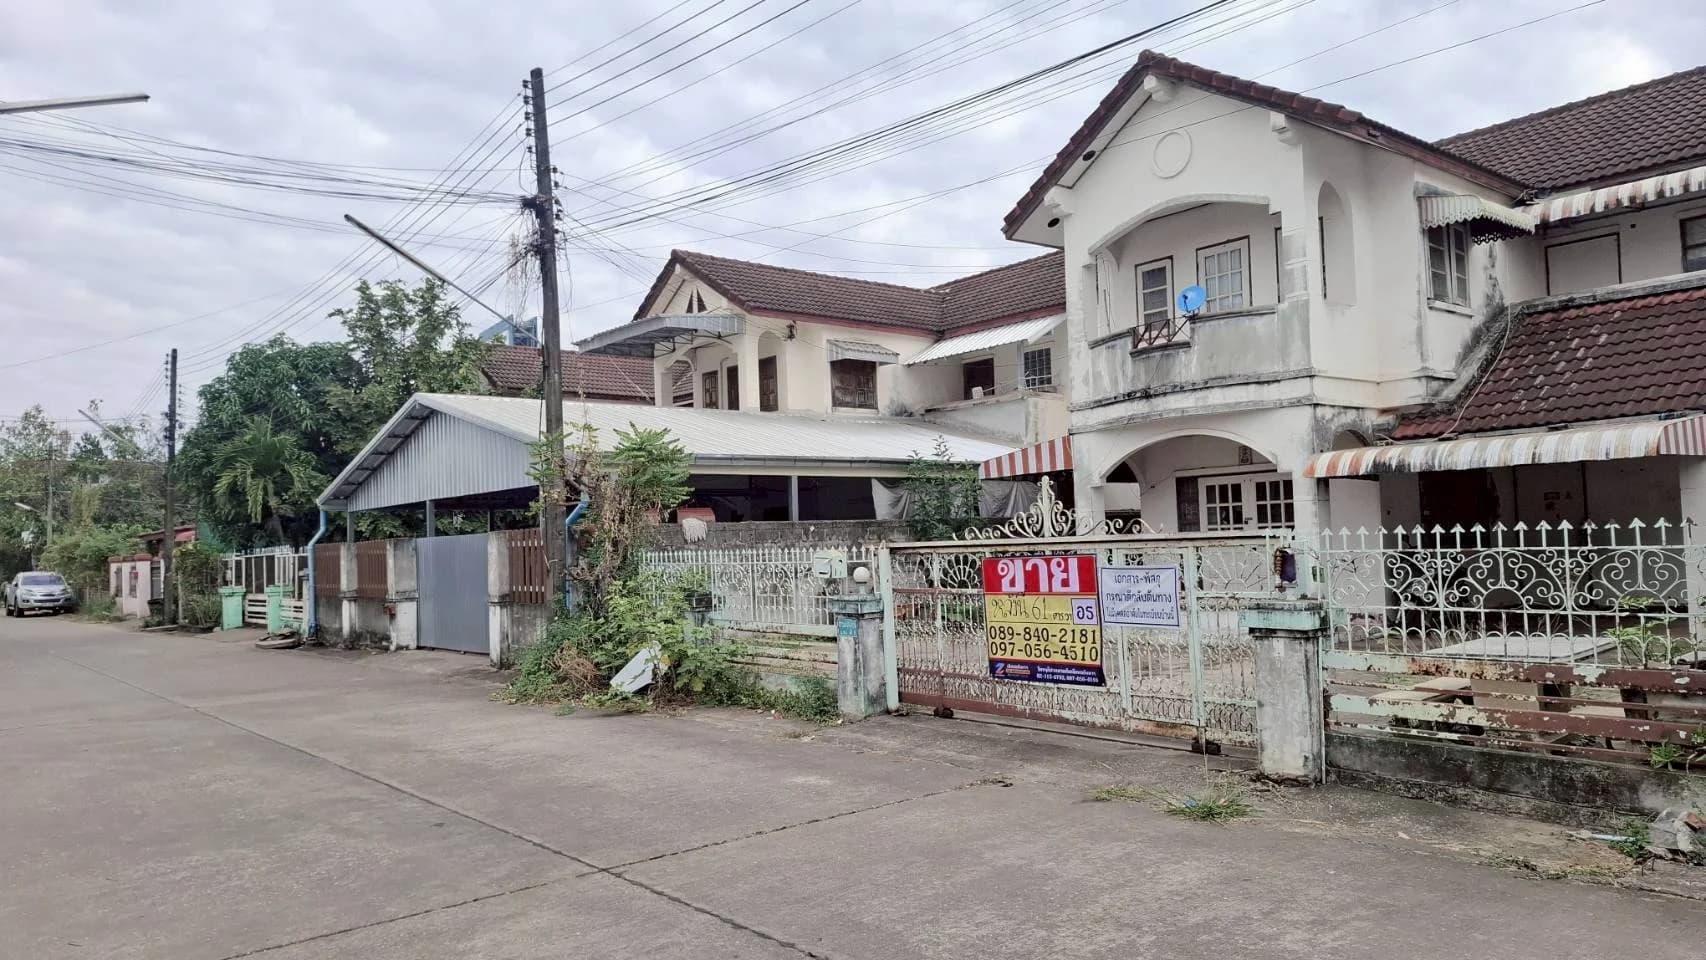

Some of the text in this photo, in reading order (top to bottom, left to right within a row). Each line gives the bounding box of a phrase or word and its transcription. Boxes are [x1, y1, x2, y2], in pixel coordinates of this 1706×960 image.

[997, 557, 1080, 592] ขาย
[1031, 597, 1048, 620] 61
[989, 626, 1097, 645] 089-840-2181
[990, 641, 1099, 662] 097-056-4510
